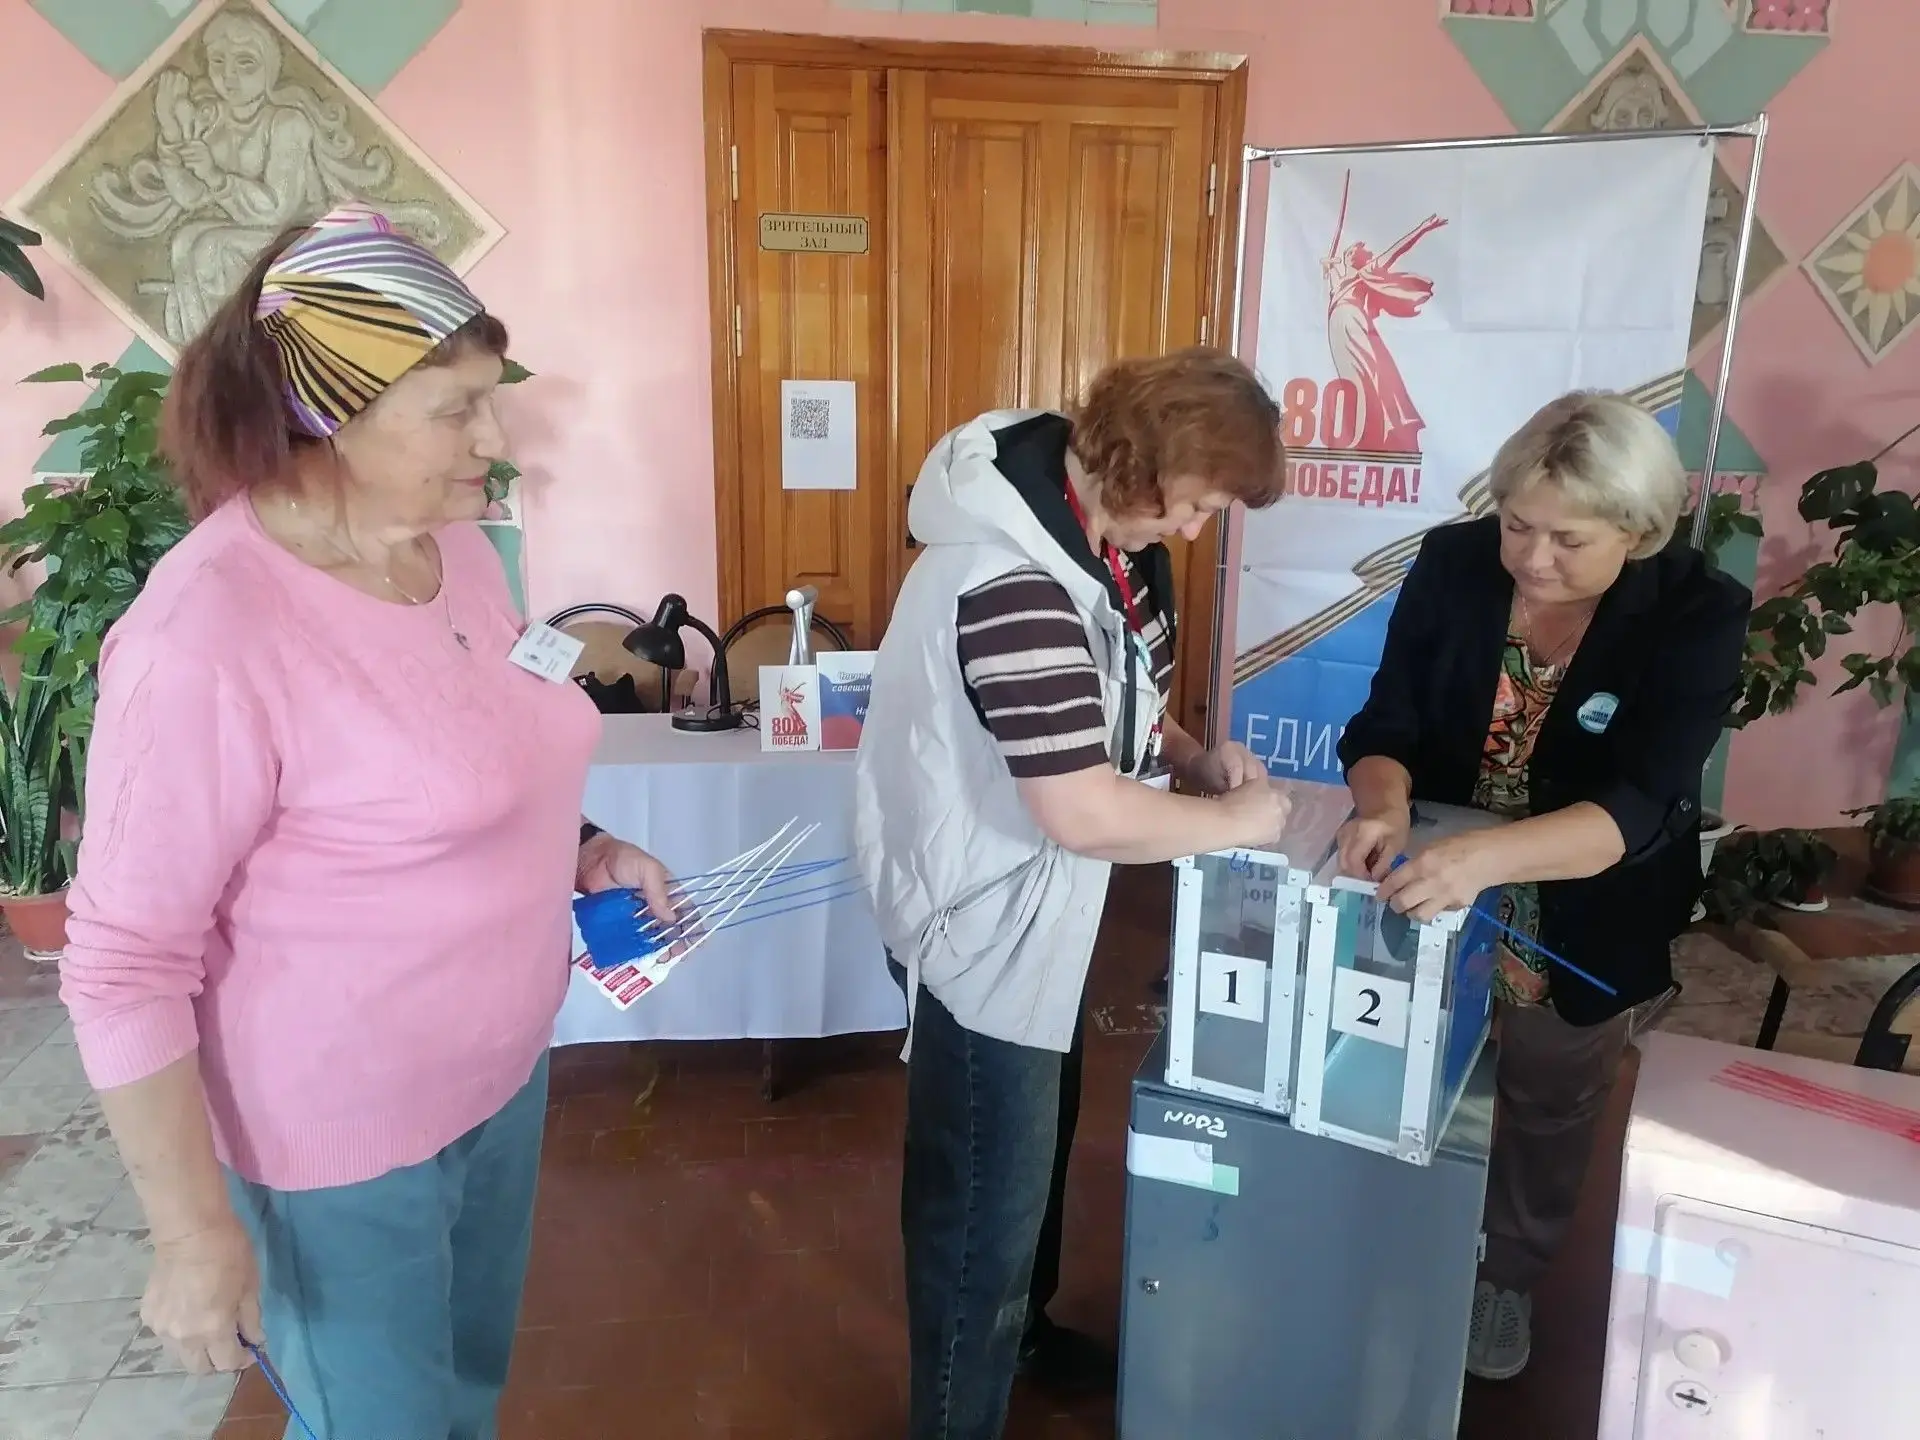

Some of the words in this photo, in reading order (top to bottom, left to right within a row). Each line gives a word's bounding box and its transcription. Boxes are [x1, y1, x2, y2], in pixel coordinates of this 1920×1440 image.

[764, 219, 864, 234] ЗРИТЕЛЬНЫЙ
[800, 236, 828, 249] ЗАЛ
[1283, 378, 1358, 449] 80
[772, 718, 793, 734] 80
[771, 735, 809, 747] ПОБЕДА!
[1222, 970, 1240, 1006] 1
[1356, 988, 1382, 1027] 2
